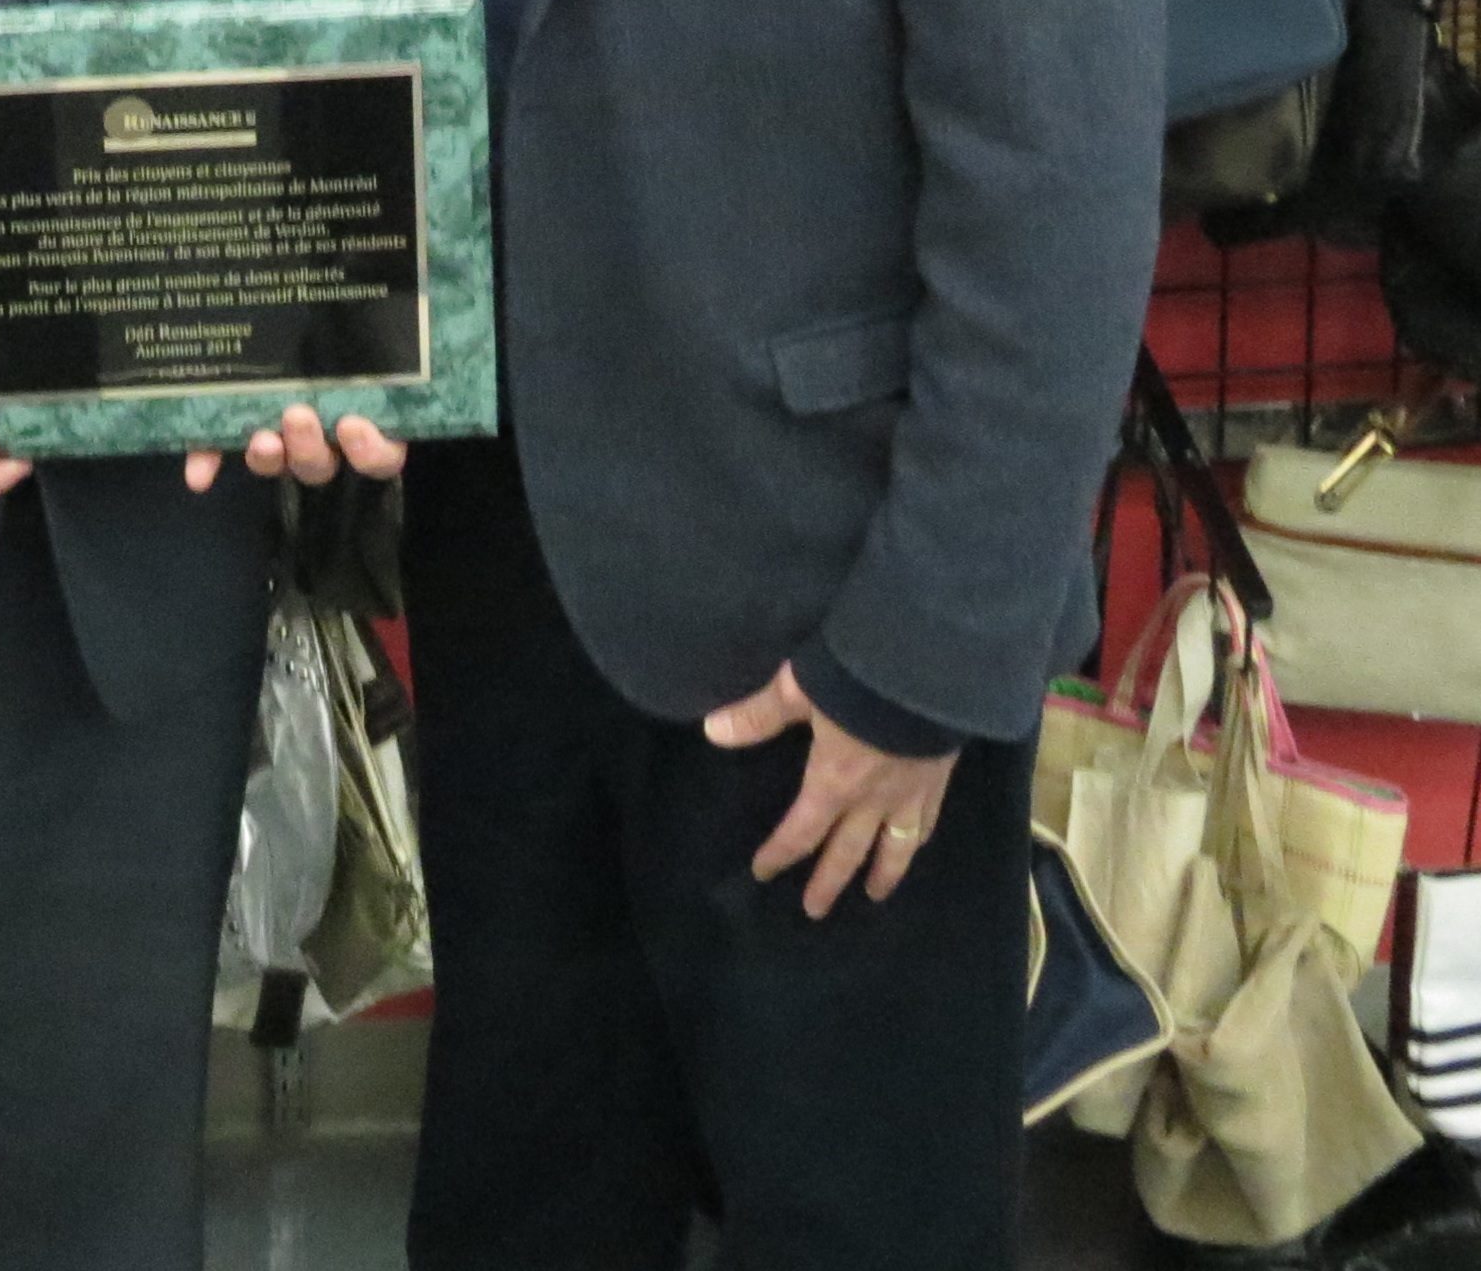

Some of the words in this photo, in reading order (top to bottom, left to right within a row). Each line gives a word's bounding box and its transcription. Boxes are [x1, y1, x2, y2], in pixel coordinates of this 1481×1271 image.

[73, 167, 101, 185] Prix
[105, 166, 129, 183] des
[133, 163, 193, 183] citoyens
[196, 163, 210, 178] et
[214, 159, 291, 181] citoyennes
[11, 191, 42, 211] plus
[46, 189, 82, 207] verts
[86, 188, 104, 205] de
[107, 187, 121, 204] la
[125, 185, 172, 206] région
[176, 179, 285, 203] métropolitaine
[288, 177, 306, 195] de
[310, 174, 377, 193] Montréal
[10, 215, 122, 235] reconnaissance
[125, 211, 143, 228] de
[248, 208, 262, 223] et
[266, 205, 284, 222] de
[288, 204, 302, 221] la
[305, 201, 381, 223] générosité
[37, 234, 57, 250] du
[61, 231, 104, 249] maire
[107, 229, 125, 246] de
[253, 223, 272, 240] de
[174, 244, 192, 261] de
[195, 244, 220, 259] son
[224, 241, 272, 260] équipe
[276, 239, 289, 255] et
[295, 237, 312, 254] de
[341, 234, 407, 252] résidents
[29, 280, 62, 296] Pour
[65, 279, 79, 295] le
[82, 276, 113, 297] plus
[116, 274, 160, 294] grand
[164, 271, 220, 290] nombre
[223, 270, 241, 287] de
[244, 268, 280, 286] dons
[283, 266, 345, 284] collectés
[9, 299, 49, 319] profit
[54, 298, 71, 314] de
[176, 290, 201, 308] but
[206, 290, 234, 307] non
[238, 286, 295, 306] lucratif
[297, 283, 389, 303] Renaissance
[159, 321, 252, 341] Renaissance
[136, 340, 202, 359] Automne
[206, 339, 242, 356] 2014
